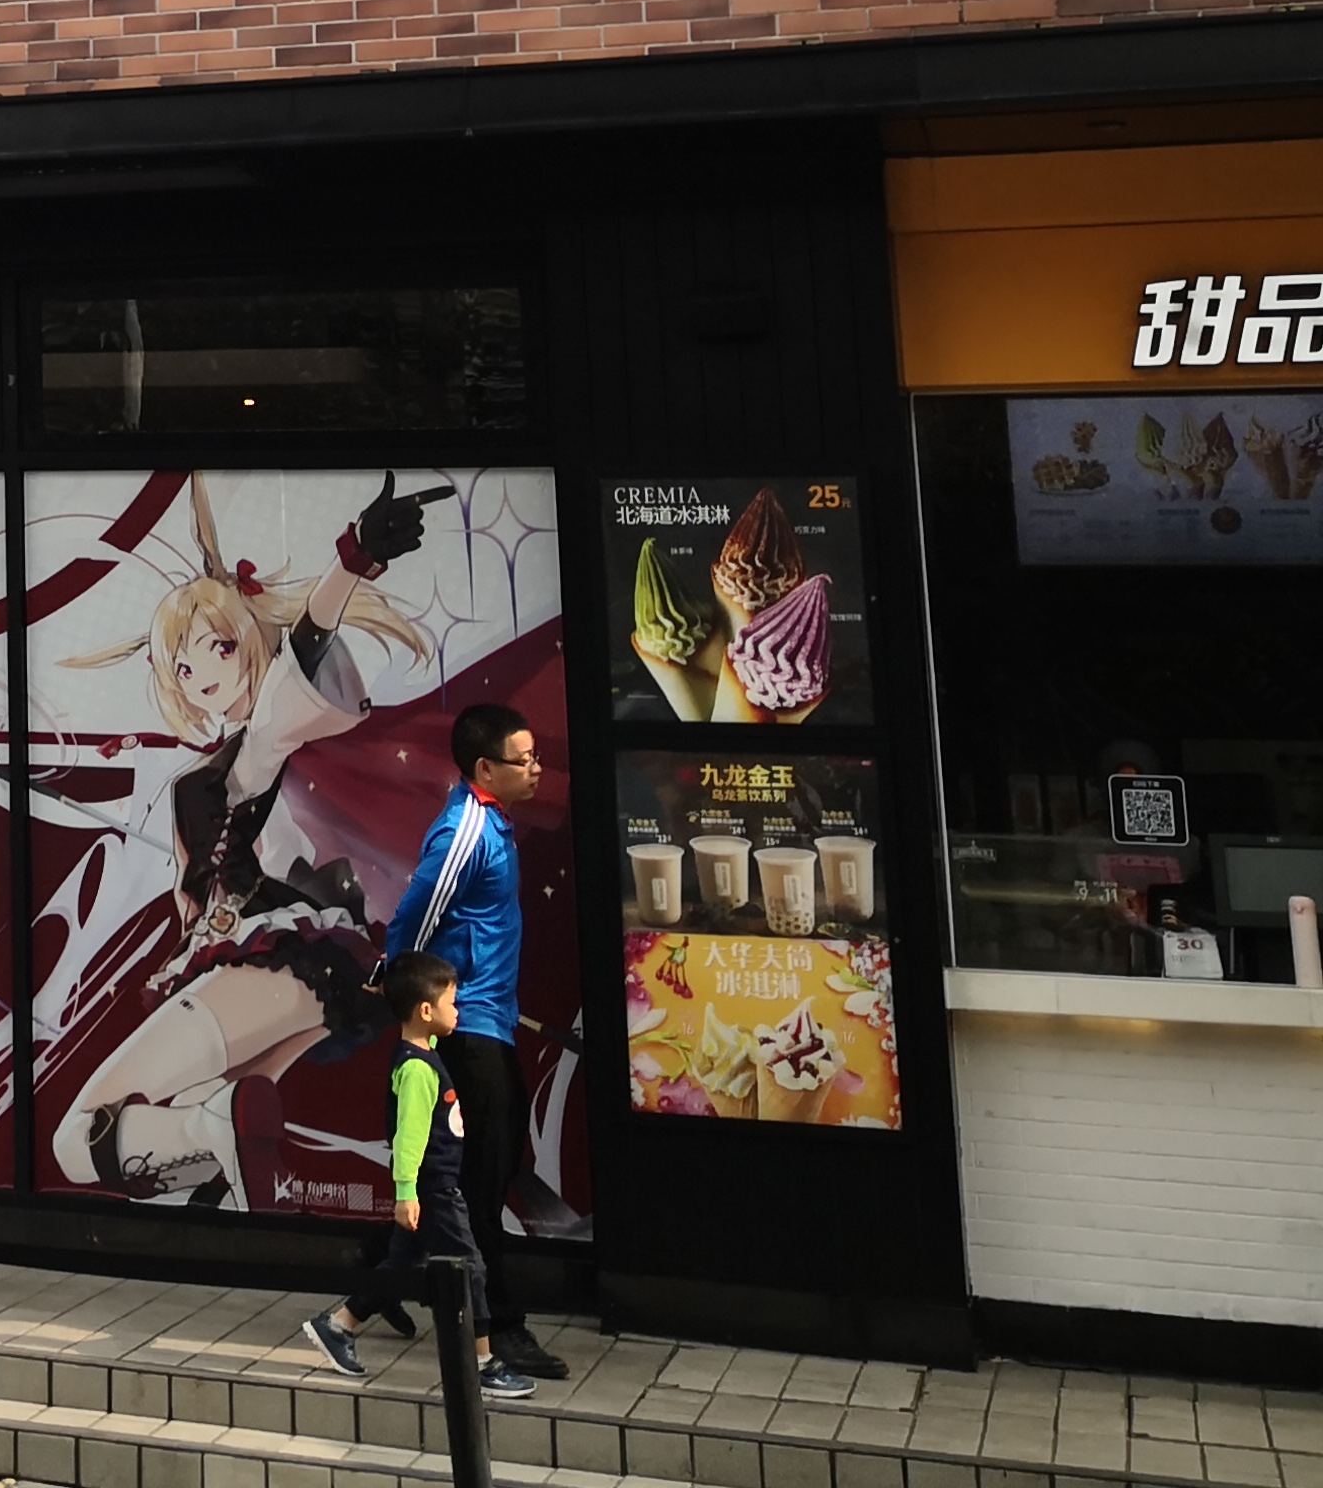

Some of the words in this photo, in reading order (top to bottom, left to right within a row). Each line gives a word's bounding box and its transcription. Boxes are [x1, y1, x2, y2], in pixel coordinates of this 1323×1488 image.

[1133, 274, 1323, 367] 甜品
[614, 486, 702, 505] CREMIA
[616, 505, 731, 526] 北海道冰淇淋
[700, 763, 795, 788] 九龙金玉
